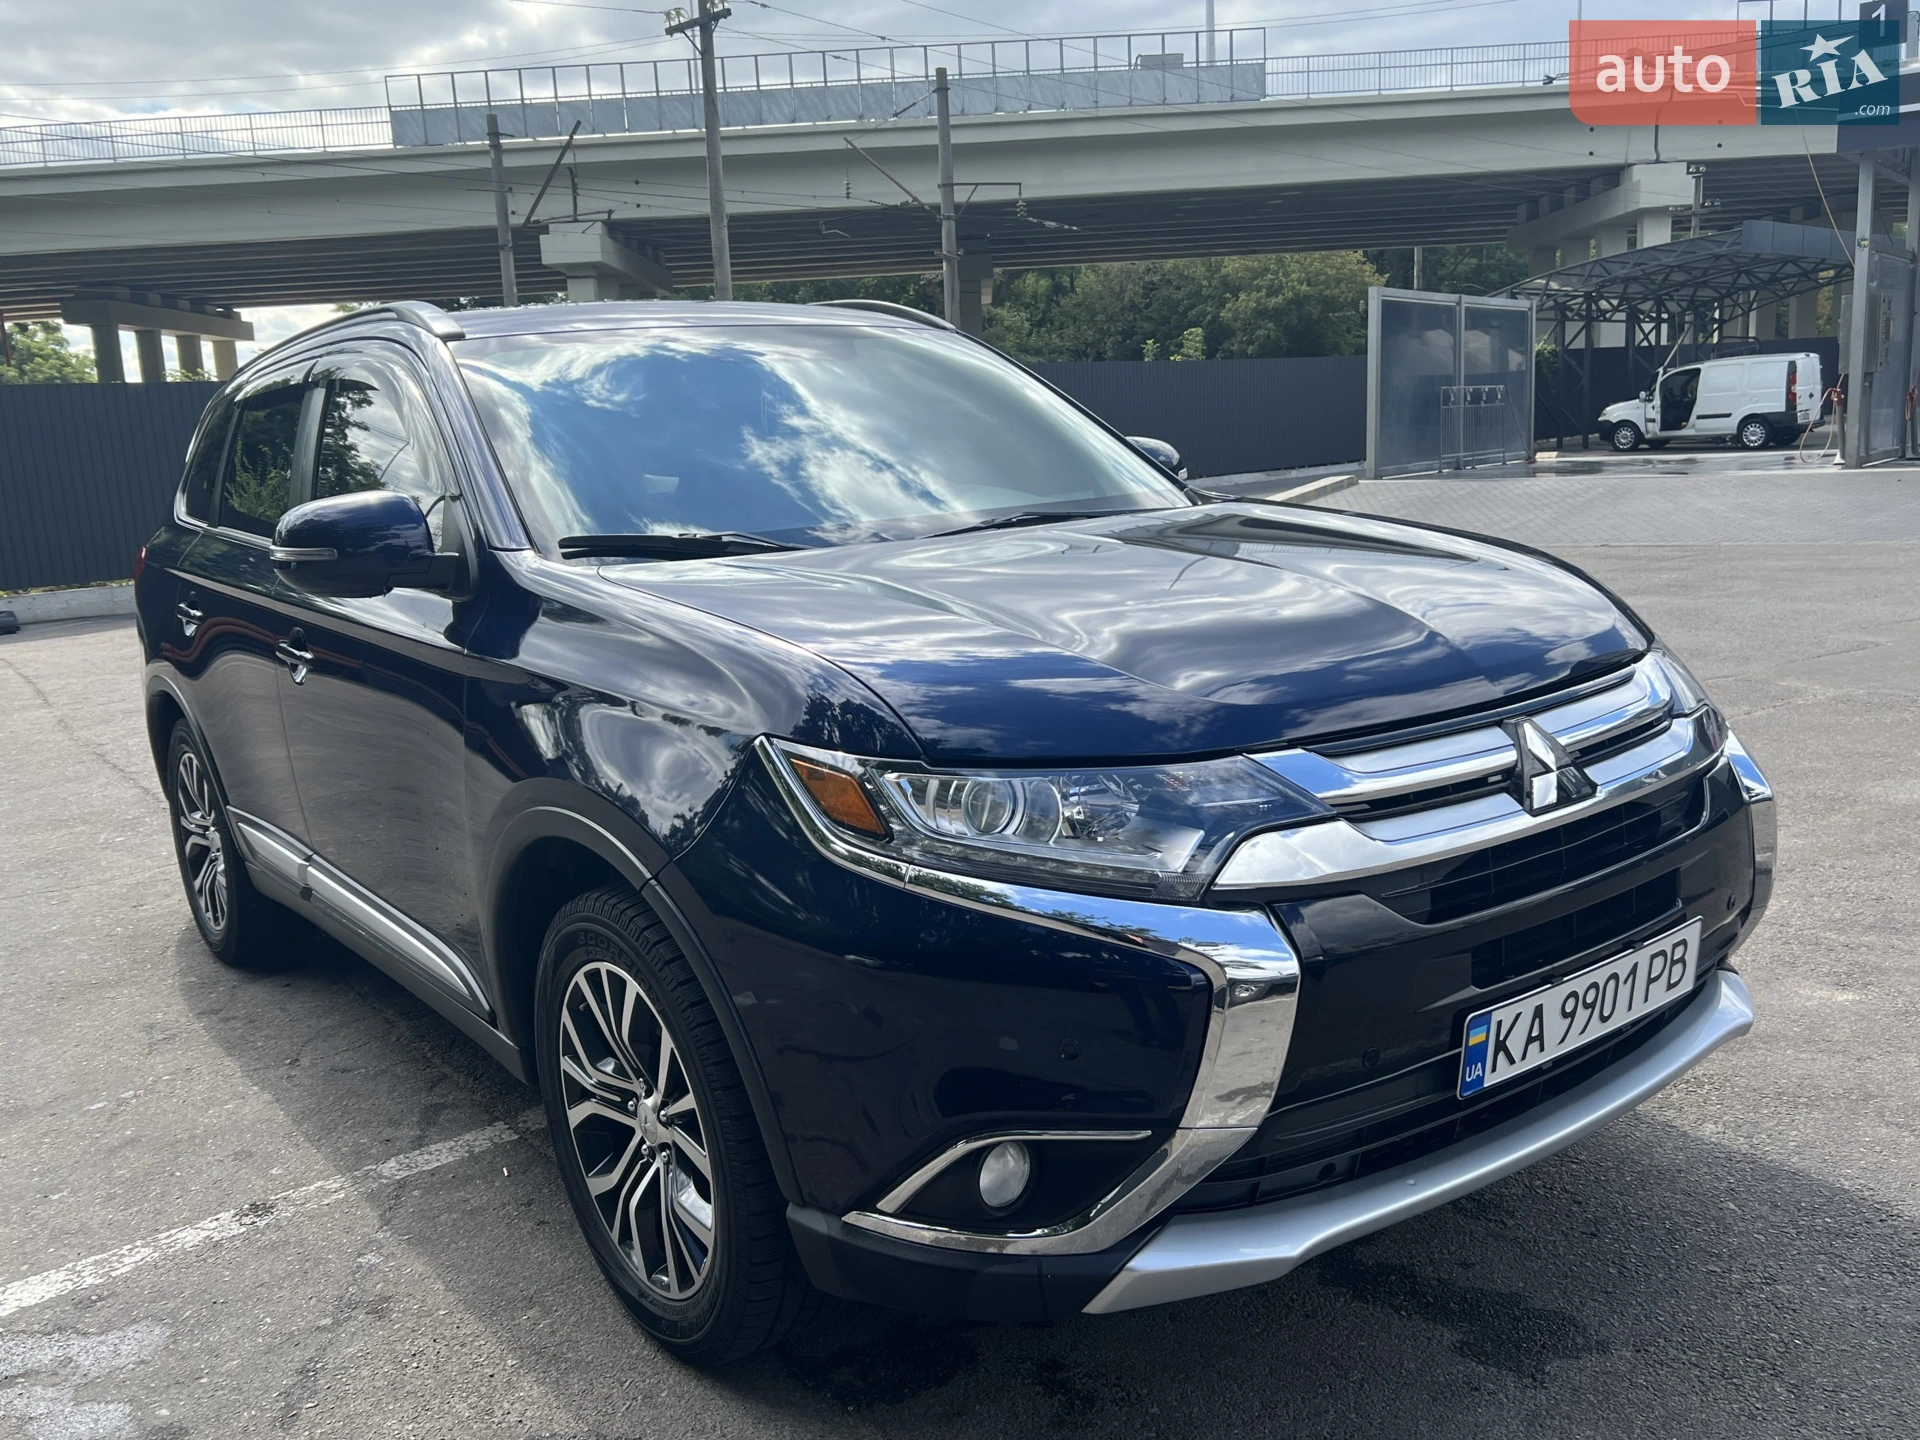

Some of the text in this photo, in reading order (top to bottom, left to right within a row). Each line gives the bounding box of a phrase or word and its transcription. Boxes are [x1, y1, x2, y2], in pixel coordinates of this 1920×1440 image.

[1871, 4, 1886, 37] 1
[1491, 938, 1689, 1074] KA 9901 PB
[1465, 1062, 1483, 1082] UA
